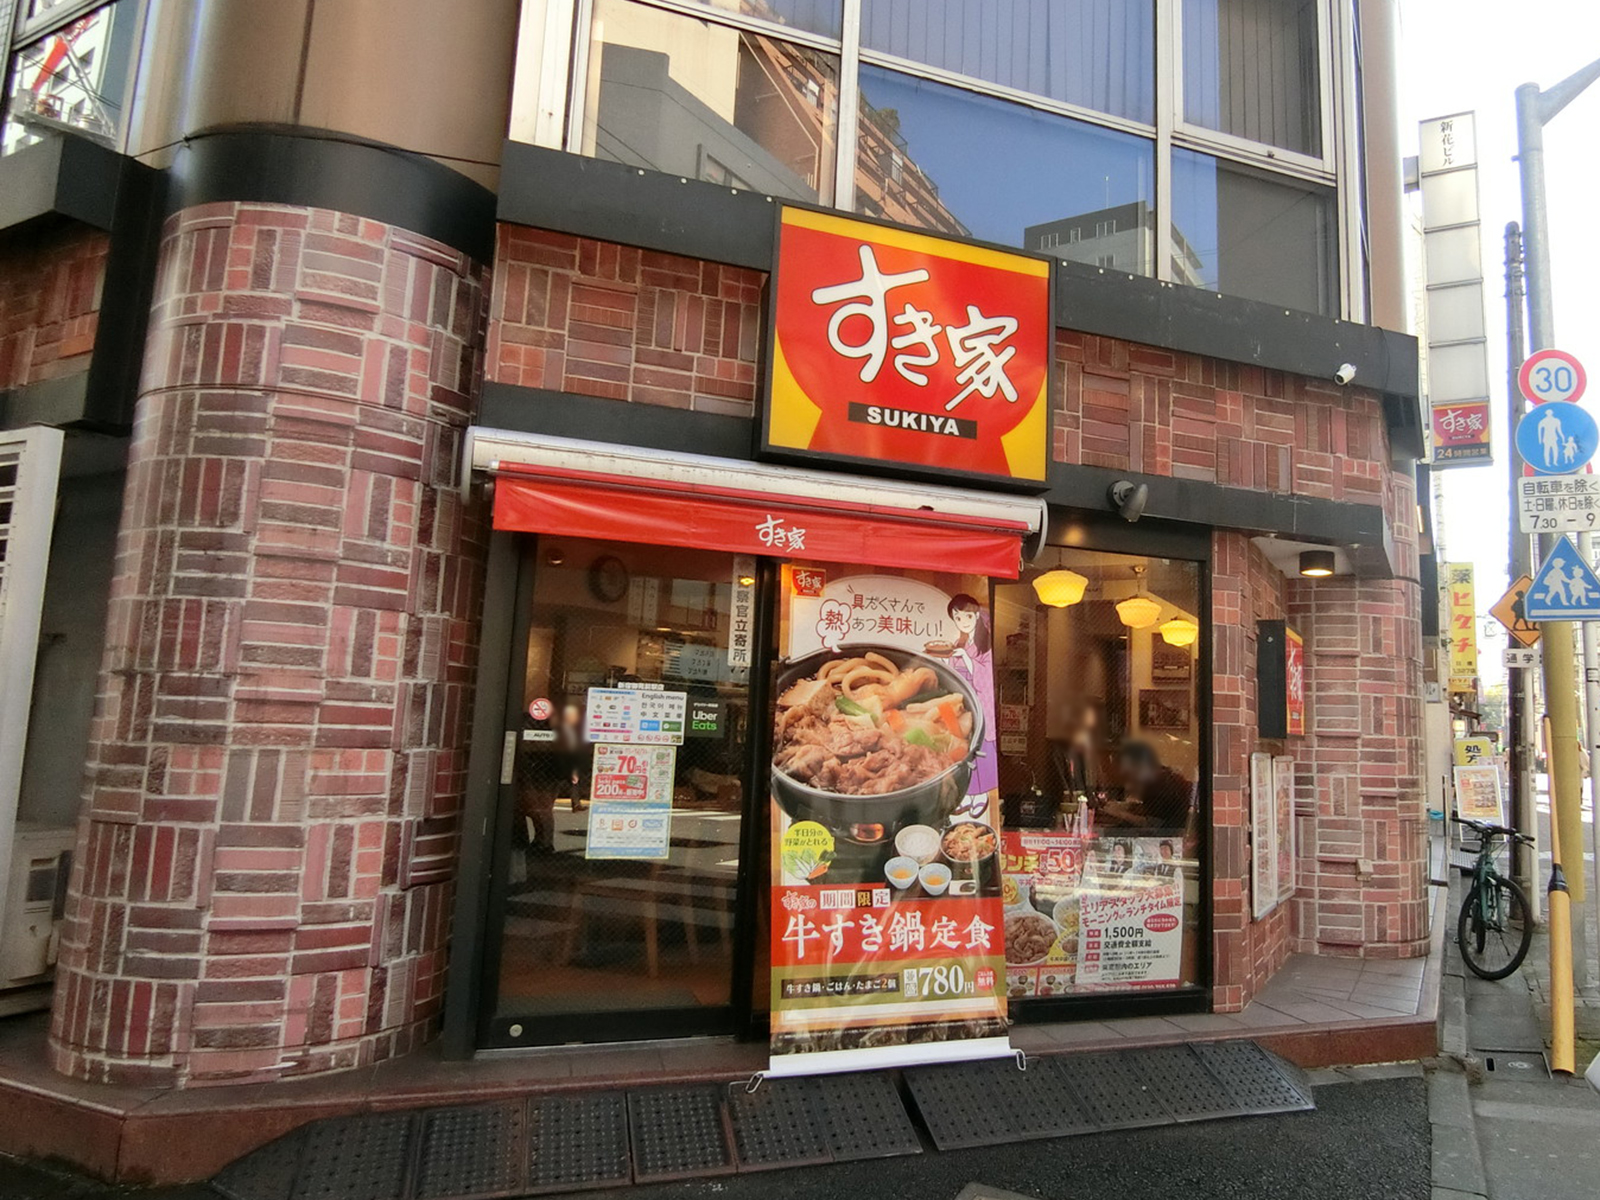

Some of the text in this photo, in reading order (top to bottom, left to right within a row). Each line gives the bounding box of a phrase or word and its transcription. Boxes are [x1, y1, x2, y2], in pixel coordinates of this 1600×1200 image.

[1440, 120, 1455, 167] 新花ビル
[811, 243, 1019, 411] すき家
[1535, 366, 1572, 393] 30
[866, 406, 960, 437] SUKIYA
[1439, 409, 1483, 434] すき家
[1523, 479, 1599, 495] 自転車を除く
[1586, 512, 1596, 527] 9
[755, 514, 806, 552] すき家
[795, 569, 822, 590] すき家
[851, 593, 925, 614] 具だくさんで
[1506, 652, 1534, 664] 通学
[641, 692, 665, 701] English
[692, 710, 718, 721] Uber
[692, 720, 717, 731] Eats
[784, 837, 828, 846] 野菜がとれる
[821, 889, 889, 909] 期間限定
[781, 910, 995, 959] 牛すき鍋定食
[1104, 926, 1143, 940] 1,500円
[919, 964, 975, 996] 780円
